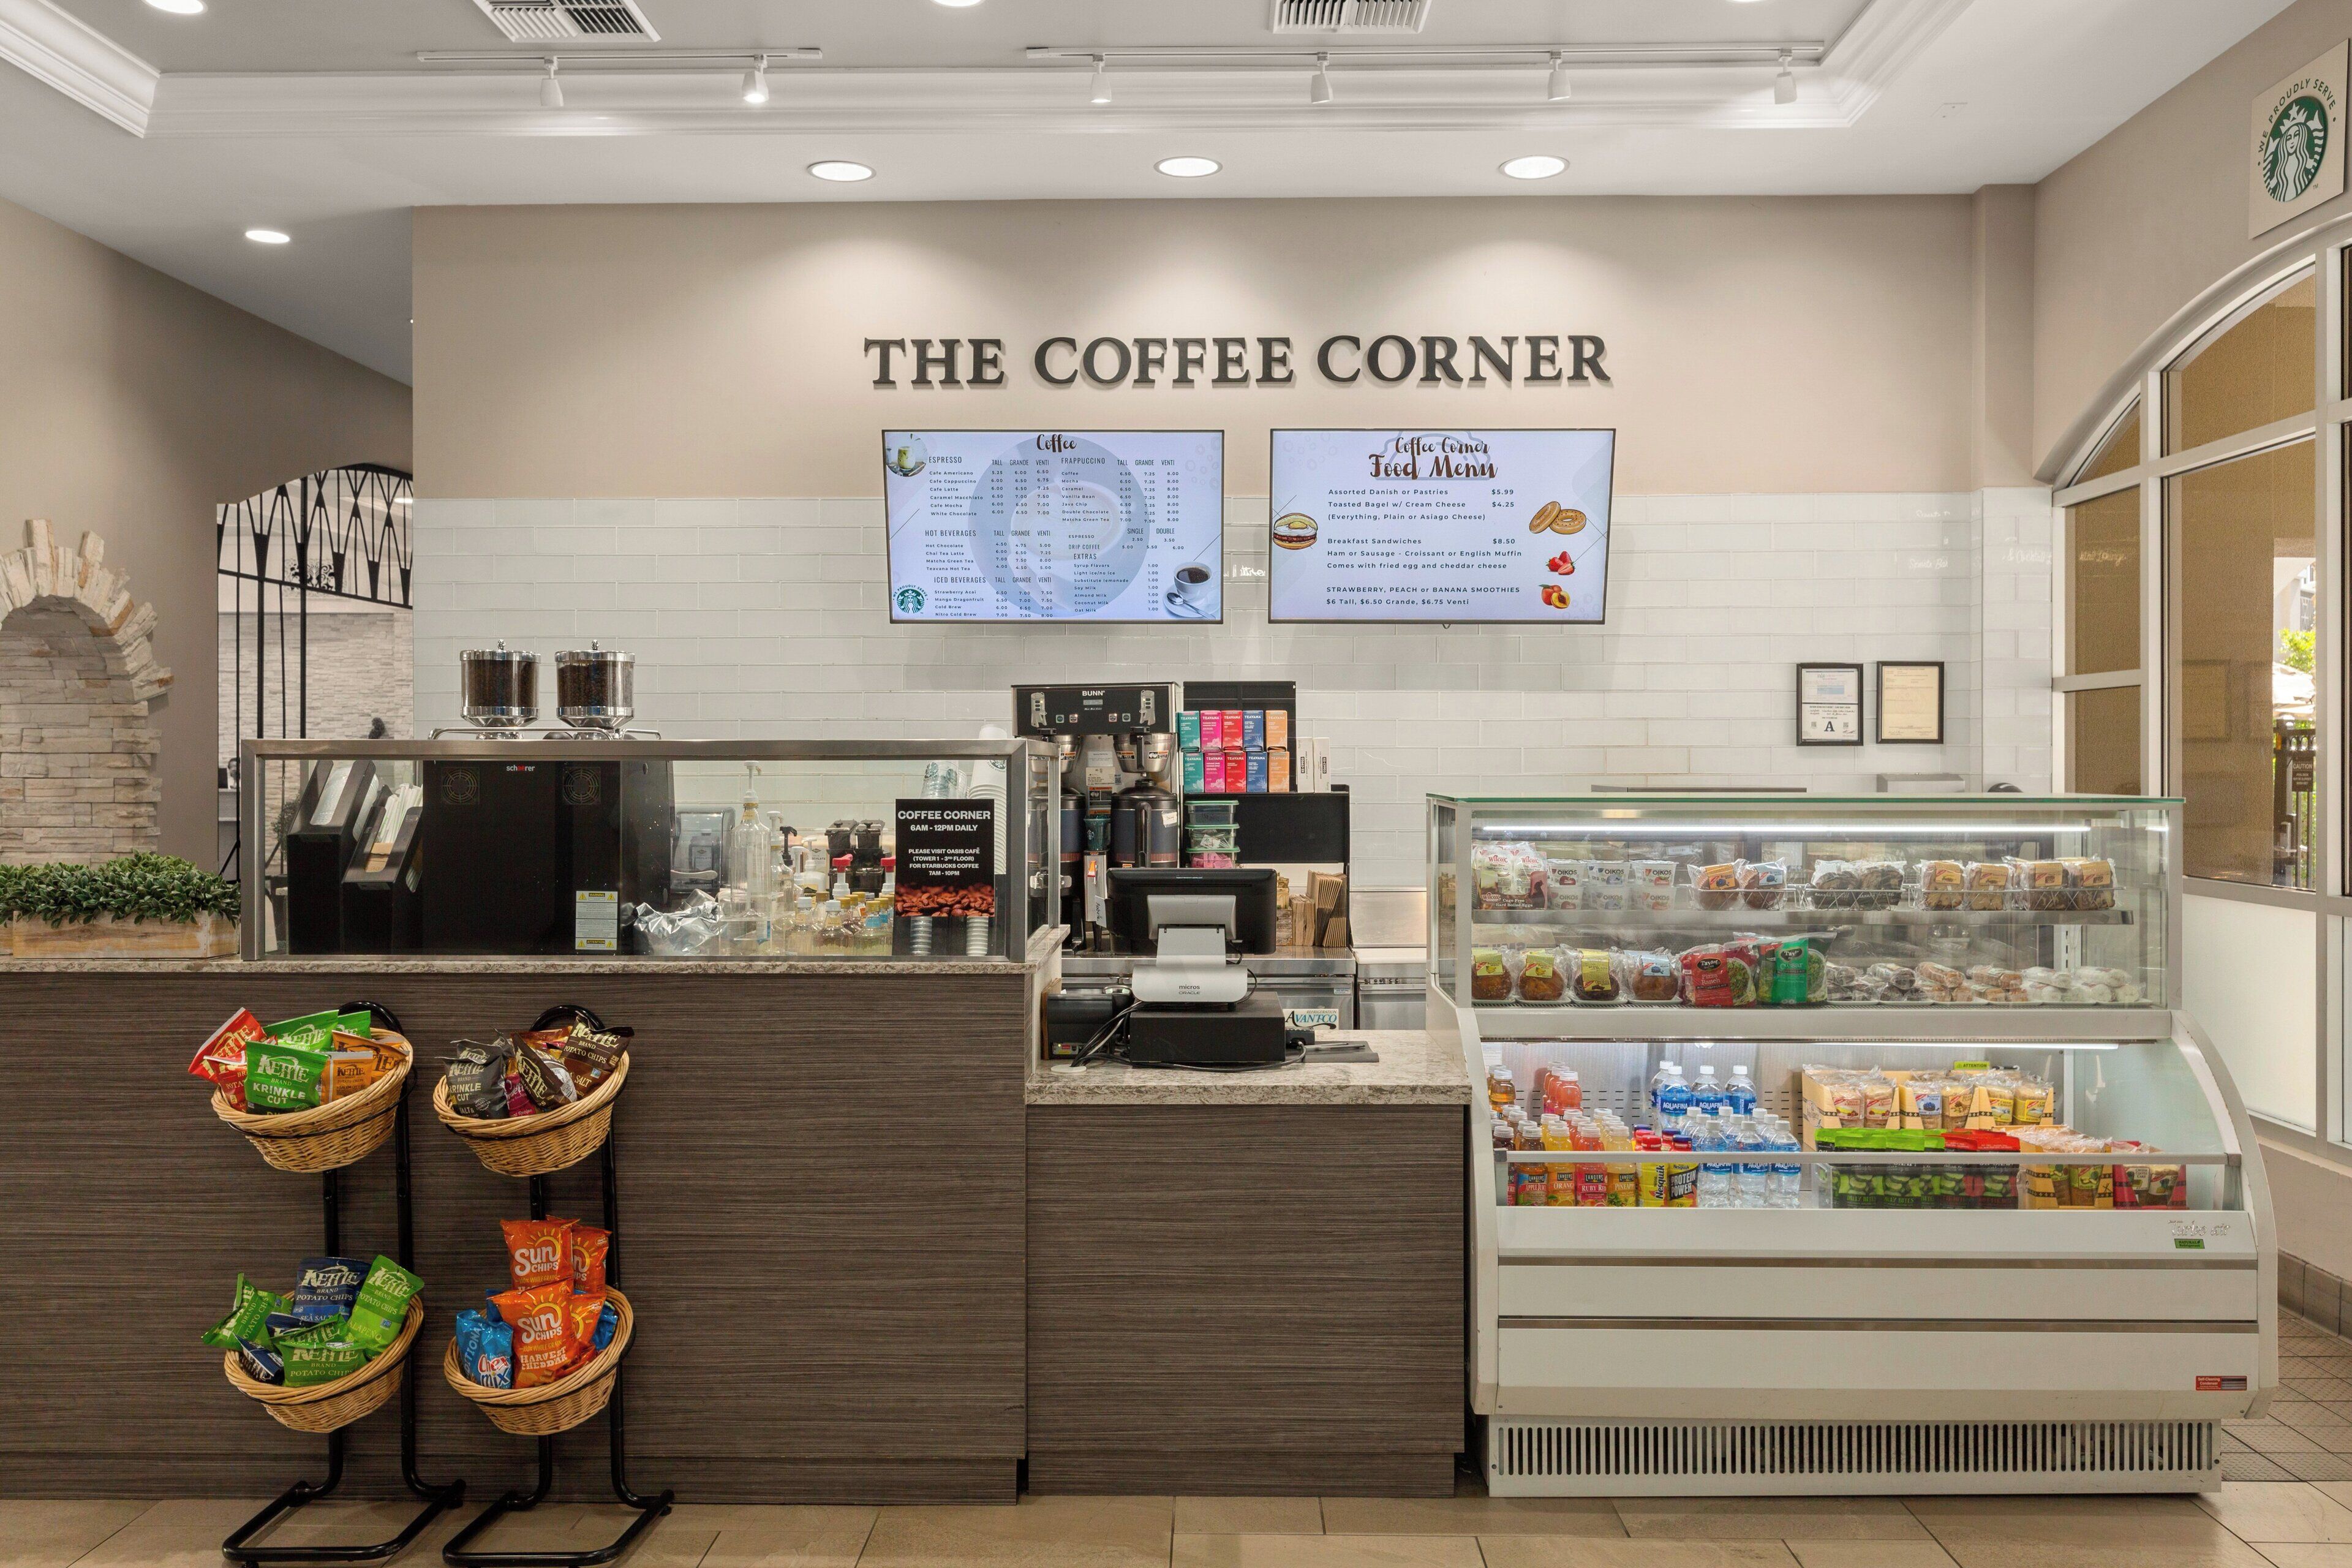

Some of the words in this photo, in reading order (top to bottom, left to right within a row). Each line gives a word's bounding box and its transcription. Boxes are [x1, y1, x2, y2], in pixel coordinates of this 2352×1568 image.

[2258, 130, 2268, 153] WE
[2268, 78, 2310, 123] PROUDLY
[2313, 79, 2336, 110] SERVE
[864, 336, 1005, 385] THE
[1035, 336, 1294, 385] COFFEE
[1317, 334, 1610, 383] CORNER
[1037, 434, 1076, 453] Coffee
[1396, 437, 1435, 455] Coffee
[1442, 436, 1490, 454] Corner
[1369, 454, 1420, 480] Food
[1430, 454, 1498, 478] Menu
[1824, 721, 1835, 732] A
[898, 811, 941, 820] COFFEE
[943, 810, 990, 820] CORNER
[1285, 1011, 1337, 1029] AVANTCO
[578, 1041, 596, 1049] BRAND
[564, 1046, 586, 1056] POTATO
[588, 1052, 607, 1063] CHIPS
[255, 1054, 309, 1083] KETTLE
[575, 1075, 592, 1087] SALT
[253, 1083, 306, 1099] KRINKLE
[267, 1095, 287, 1104] CUT
[1655, 1165, 1664, 1199] Nesquik
[1672, 1170, 1696, 1185] PROTEIN
[1671, 1184, 1692, 1197] POWER
[299, 1265, 360, 1287] KETTLE
[518, 1313, 562, 1343] Sun
[535, 1327, 562, 1340] CHIPS
[478, 1354, 509, 1372] Chex
[522, 1346, 566, 1363] HARVEST
[522, 1354, 567, 1370] CHEDDAR
